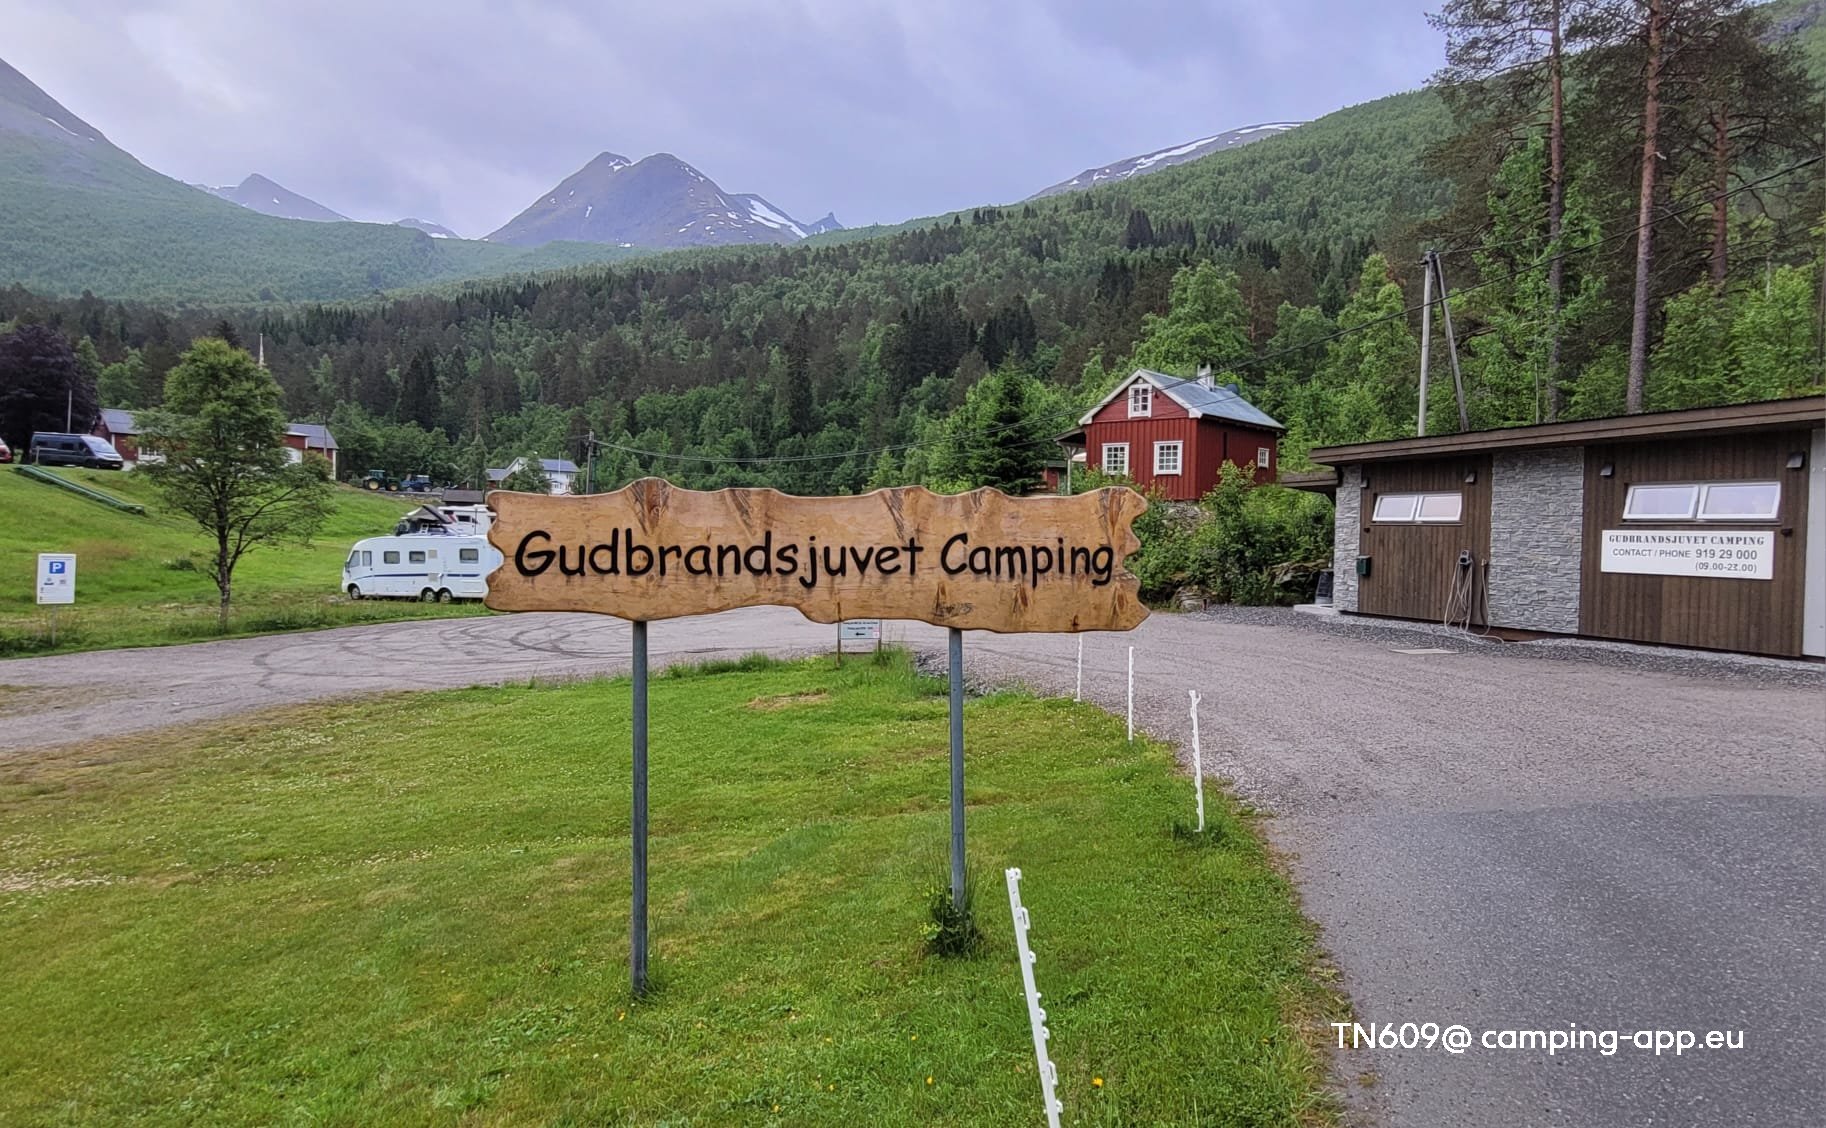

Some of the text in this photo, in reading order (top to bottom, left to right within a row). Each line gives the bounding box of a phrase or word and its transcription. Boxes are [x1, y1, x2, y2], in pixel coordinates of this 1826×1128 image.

[1609, 534, 1765, 545] GUDBRANDSJUVET CAMPING
[515, 529, 1113, 588] Gudbrandsjuvet Camping
[1612, 548, 1652, 557] CONTACT
[1659, 549, 1692, 559] PHONE
[1695, 548, 1716, 559] 919
[1718, 549, 1733, 560] 29
[1736, 549, 1758, 561] 000
[51, 562, 62, 573] P
